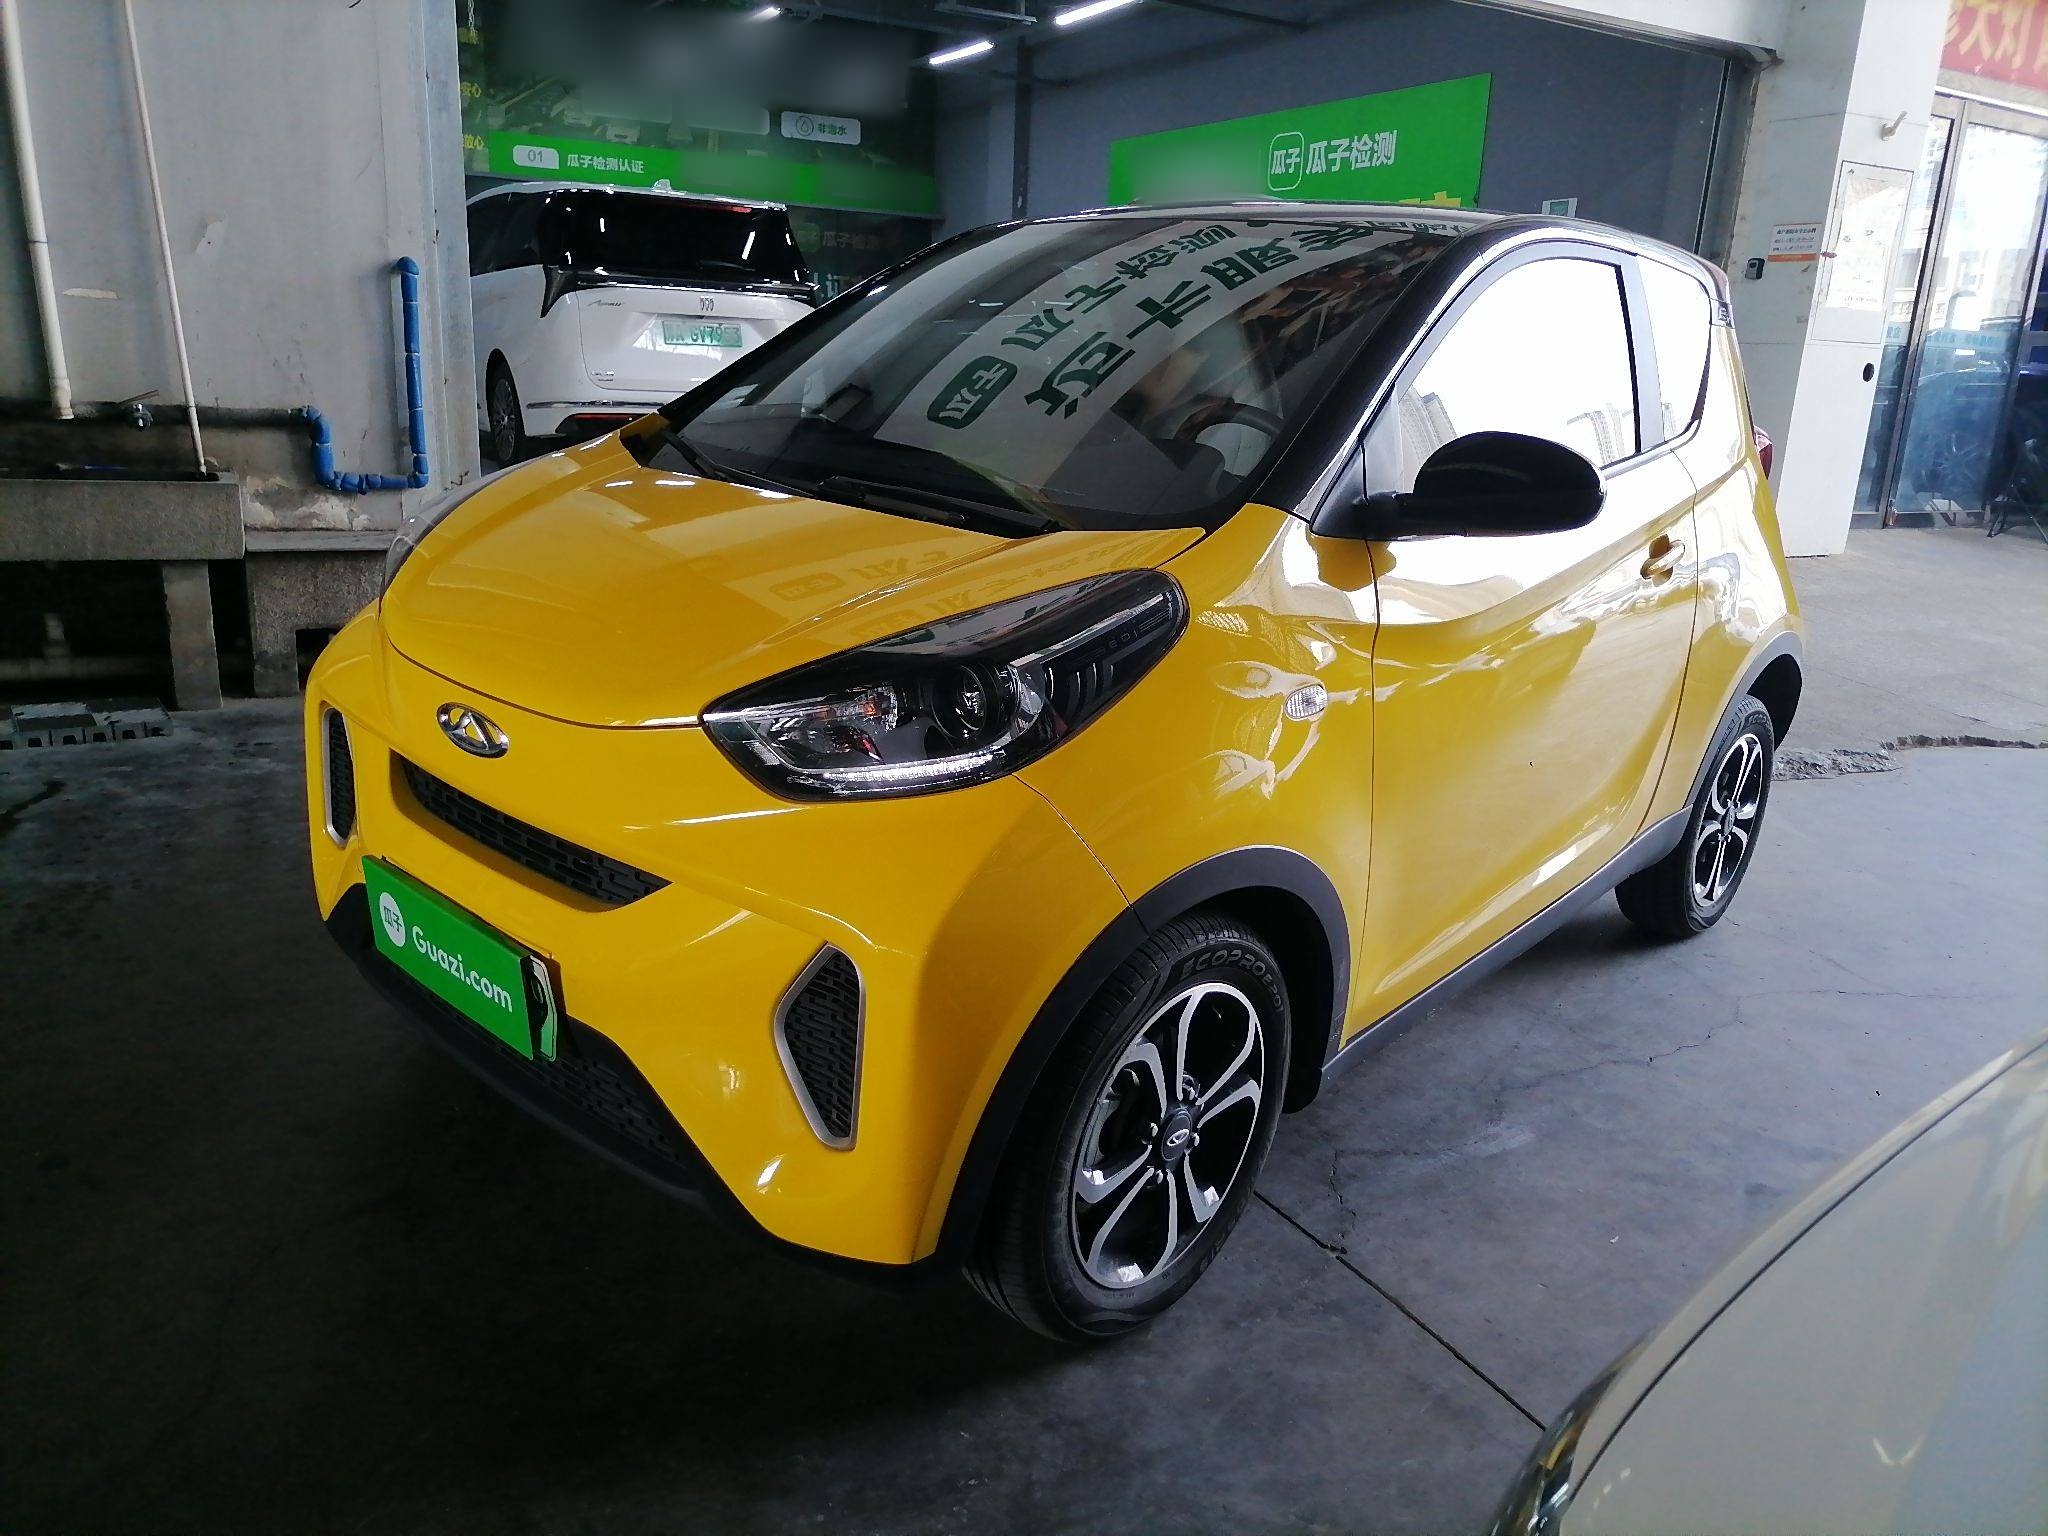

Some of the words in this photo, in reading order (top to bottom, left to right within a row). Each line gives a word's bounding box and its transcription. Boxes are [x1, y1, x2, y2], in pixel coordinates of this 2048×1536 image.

[528, 148, 544, 164] 01
[567, 153, 645, 174] 瓜子检测认证
[1270, 147, 1301, 175] 瓜子
[1306, 129, 1398, 175] 瓜子检测
[383, 905, 403, 933] 瓜子
[412, 925, 513, 1013] Guazi.com
